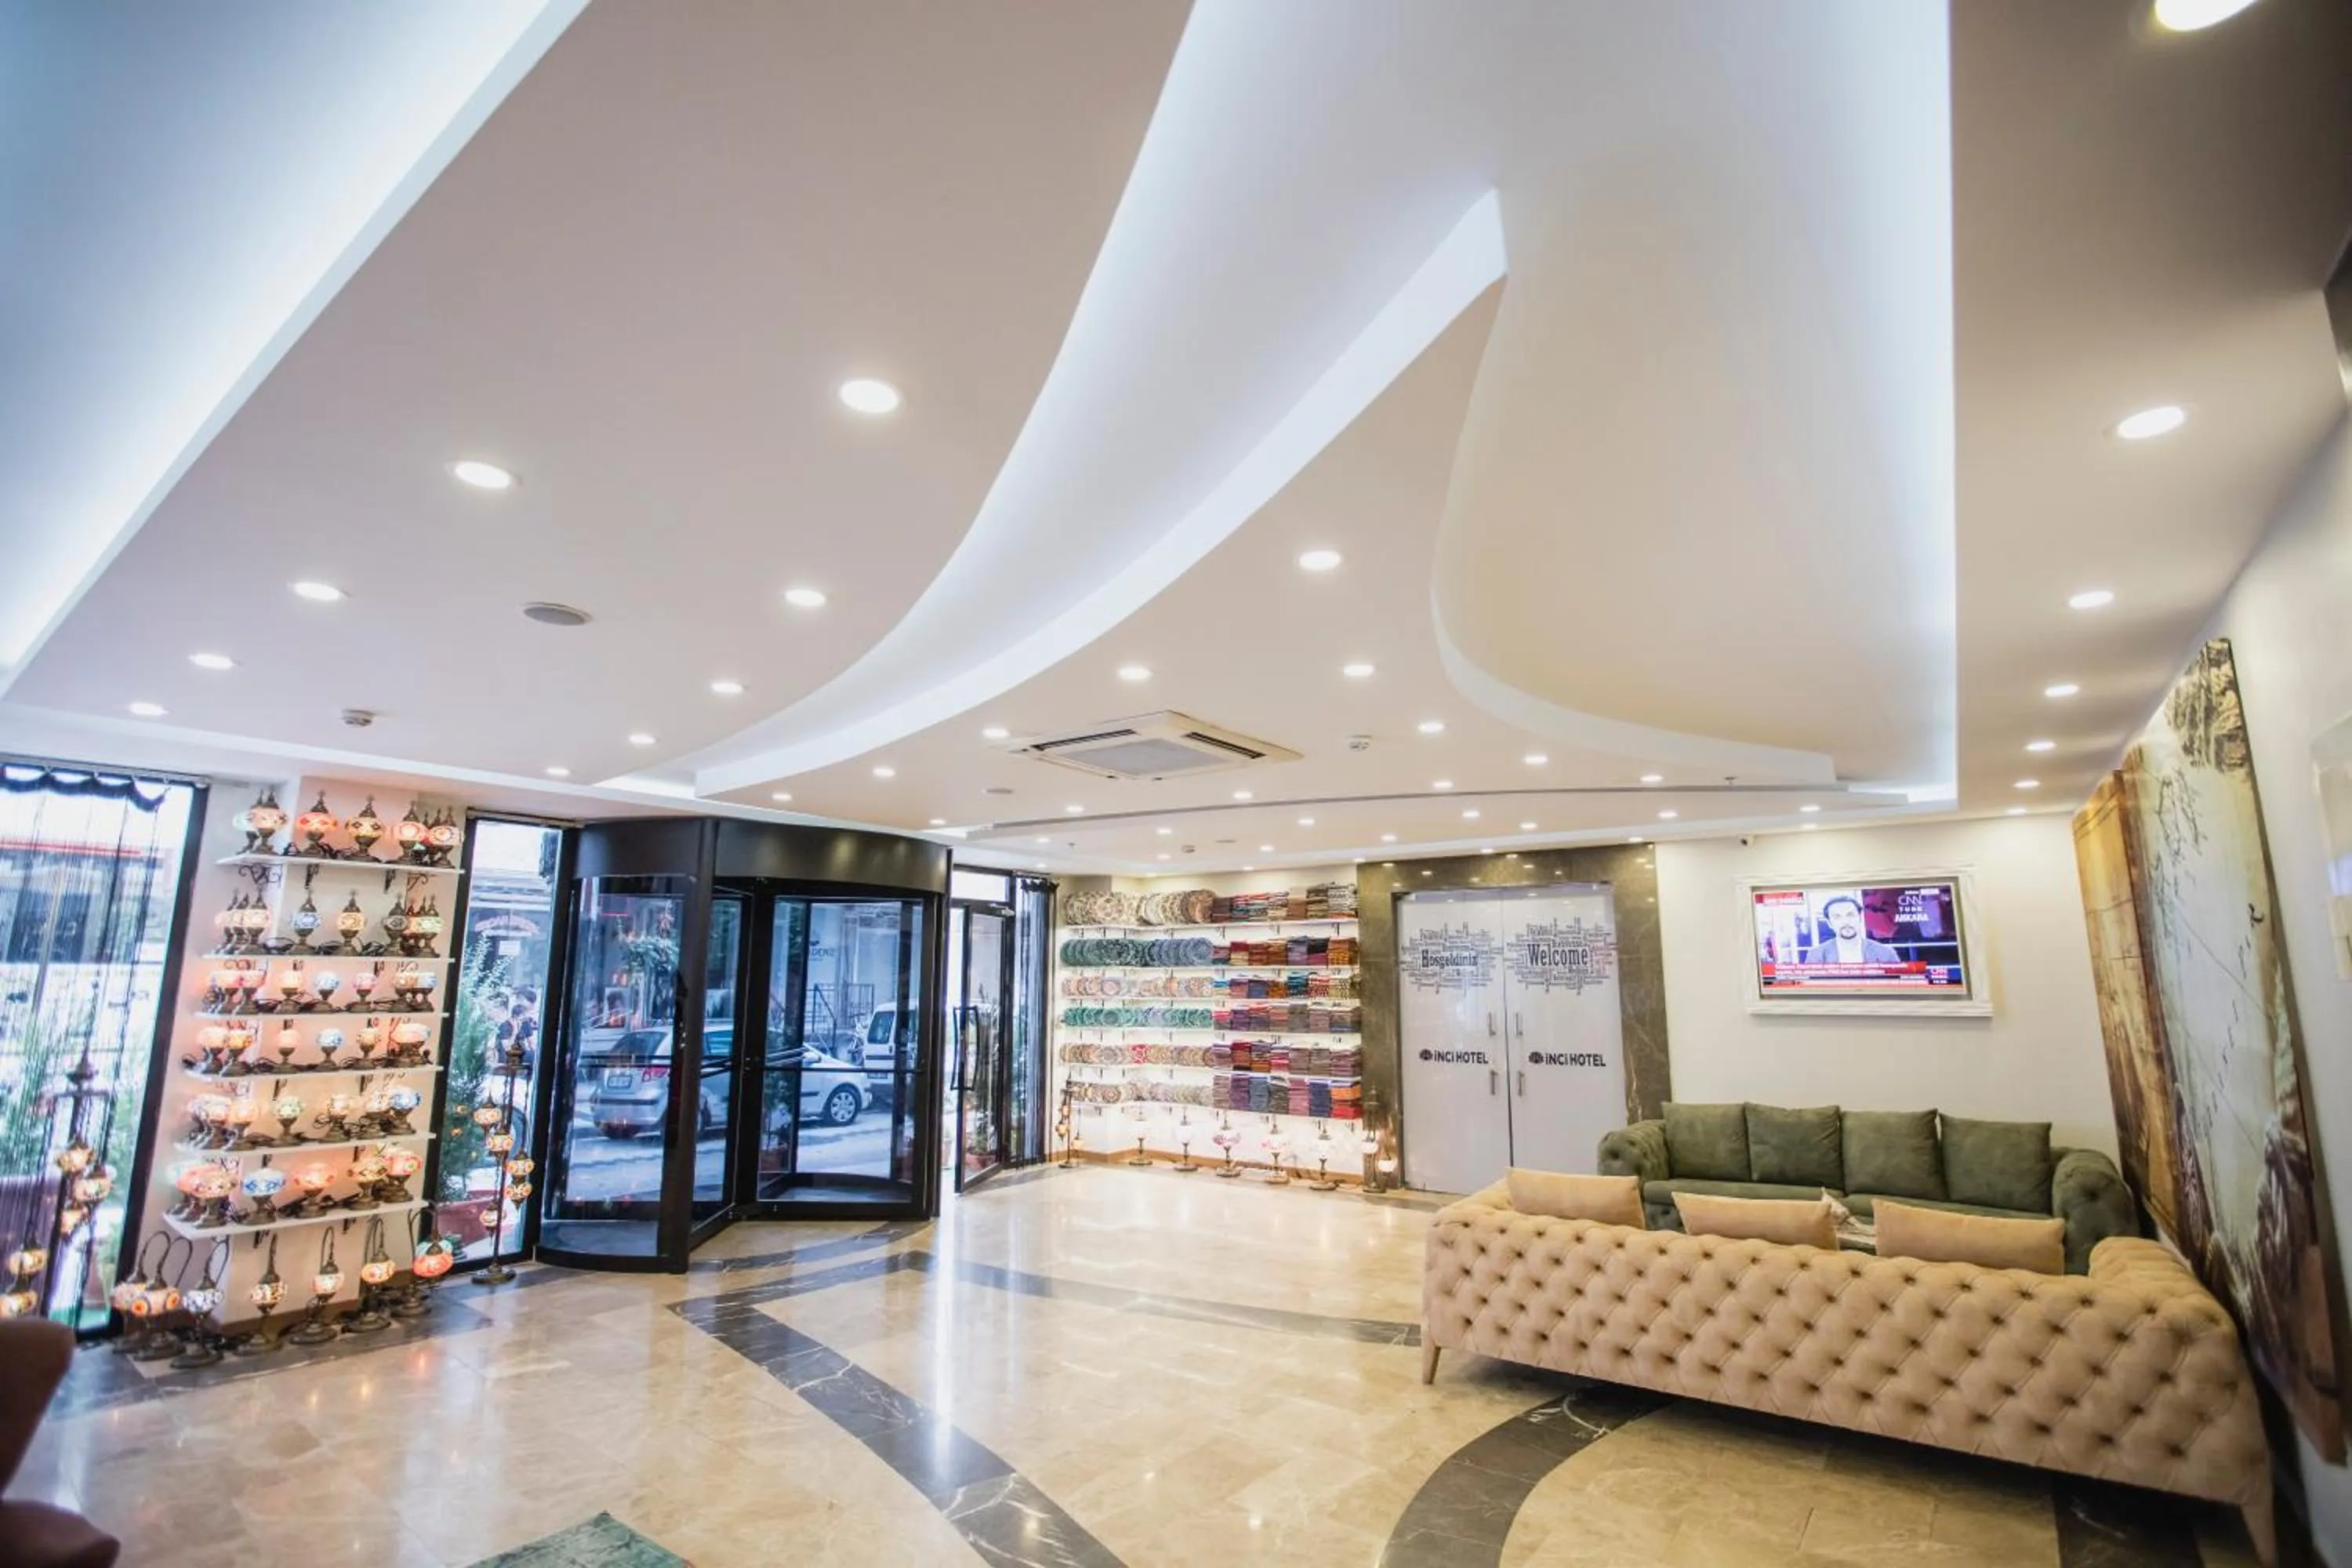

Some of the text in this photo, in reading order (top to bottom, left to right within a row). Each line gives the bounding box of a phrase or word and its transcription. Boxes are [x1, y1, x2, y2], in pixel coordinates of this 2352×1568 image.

[1898, 895, 1923, 905] CNN
[1526, 943, 1588, 966] Welcome
[1456, 1051, 1490, 1064] HOTEL
[1569, 1053, 1606, 1067] HOTEL
